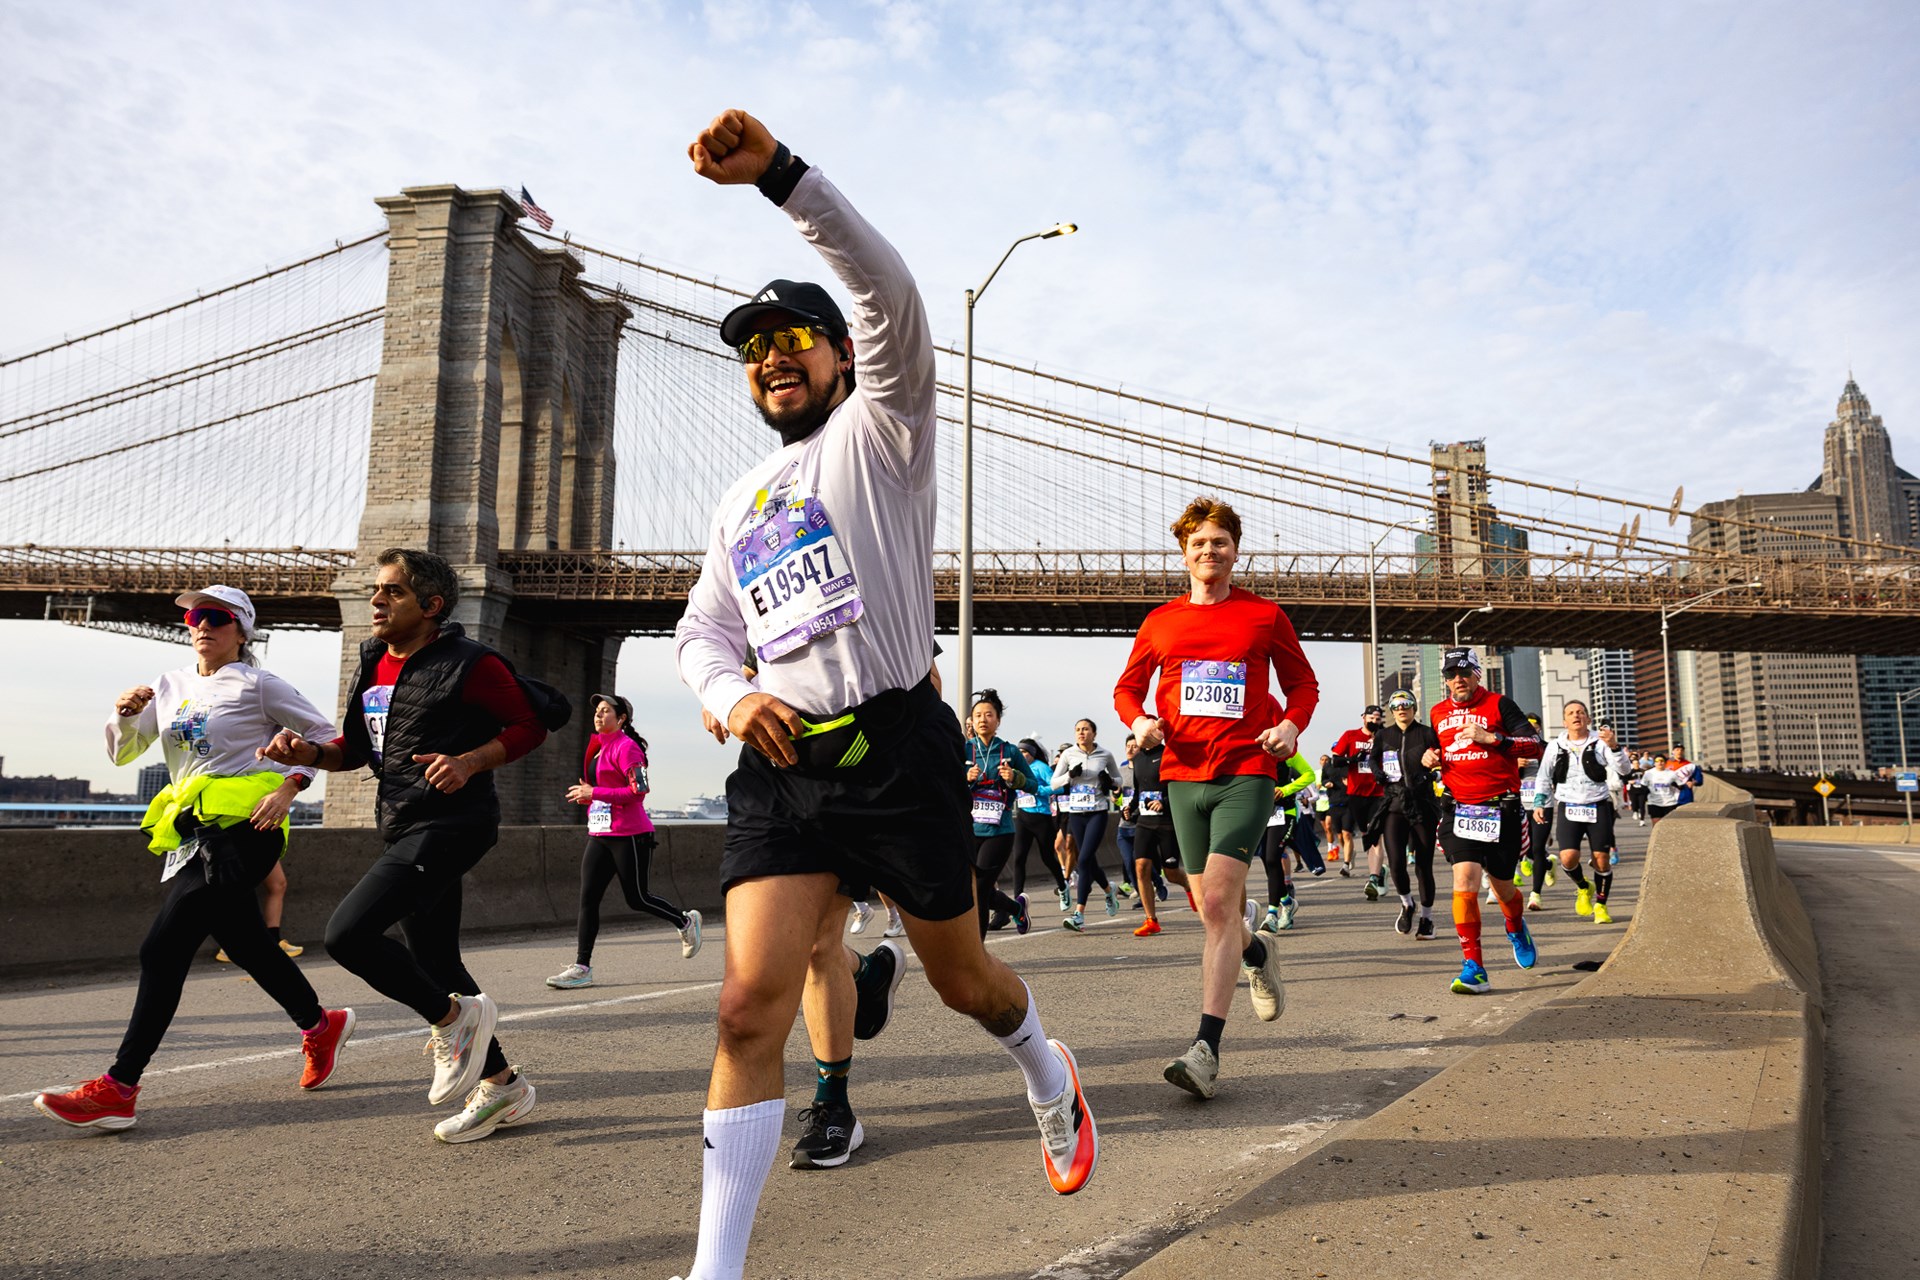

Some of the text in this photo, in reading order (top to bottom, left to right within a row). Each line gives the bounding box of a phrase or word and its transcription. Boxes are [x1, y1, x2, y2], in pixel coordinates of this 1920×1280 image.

[822, 576, 853, 594] WAVE 3
[809, 613, 837, 634] 19547
[1185, 685, 1239, 704] D23081
[370, 716, 387, 735] C1
[1444, 750, 1488, 761] Warriors
[1458, 819, 1497, 833] C18862
